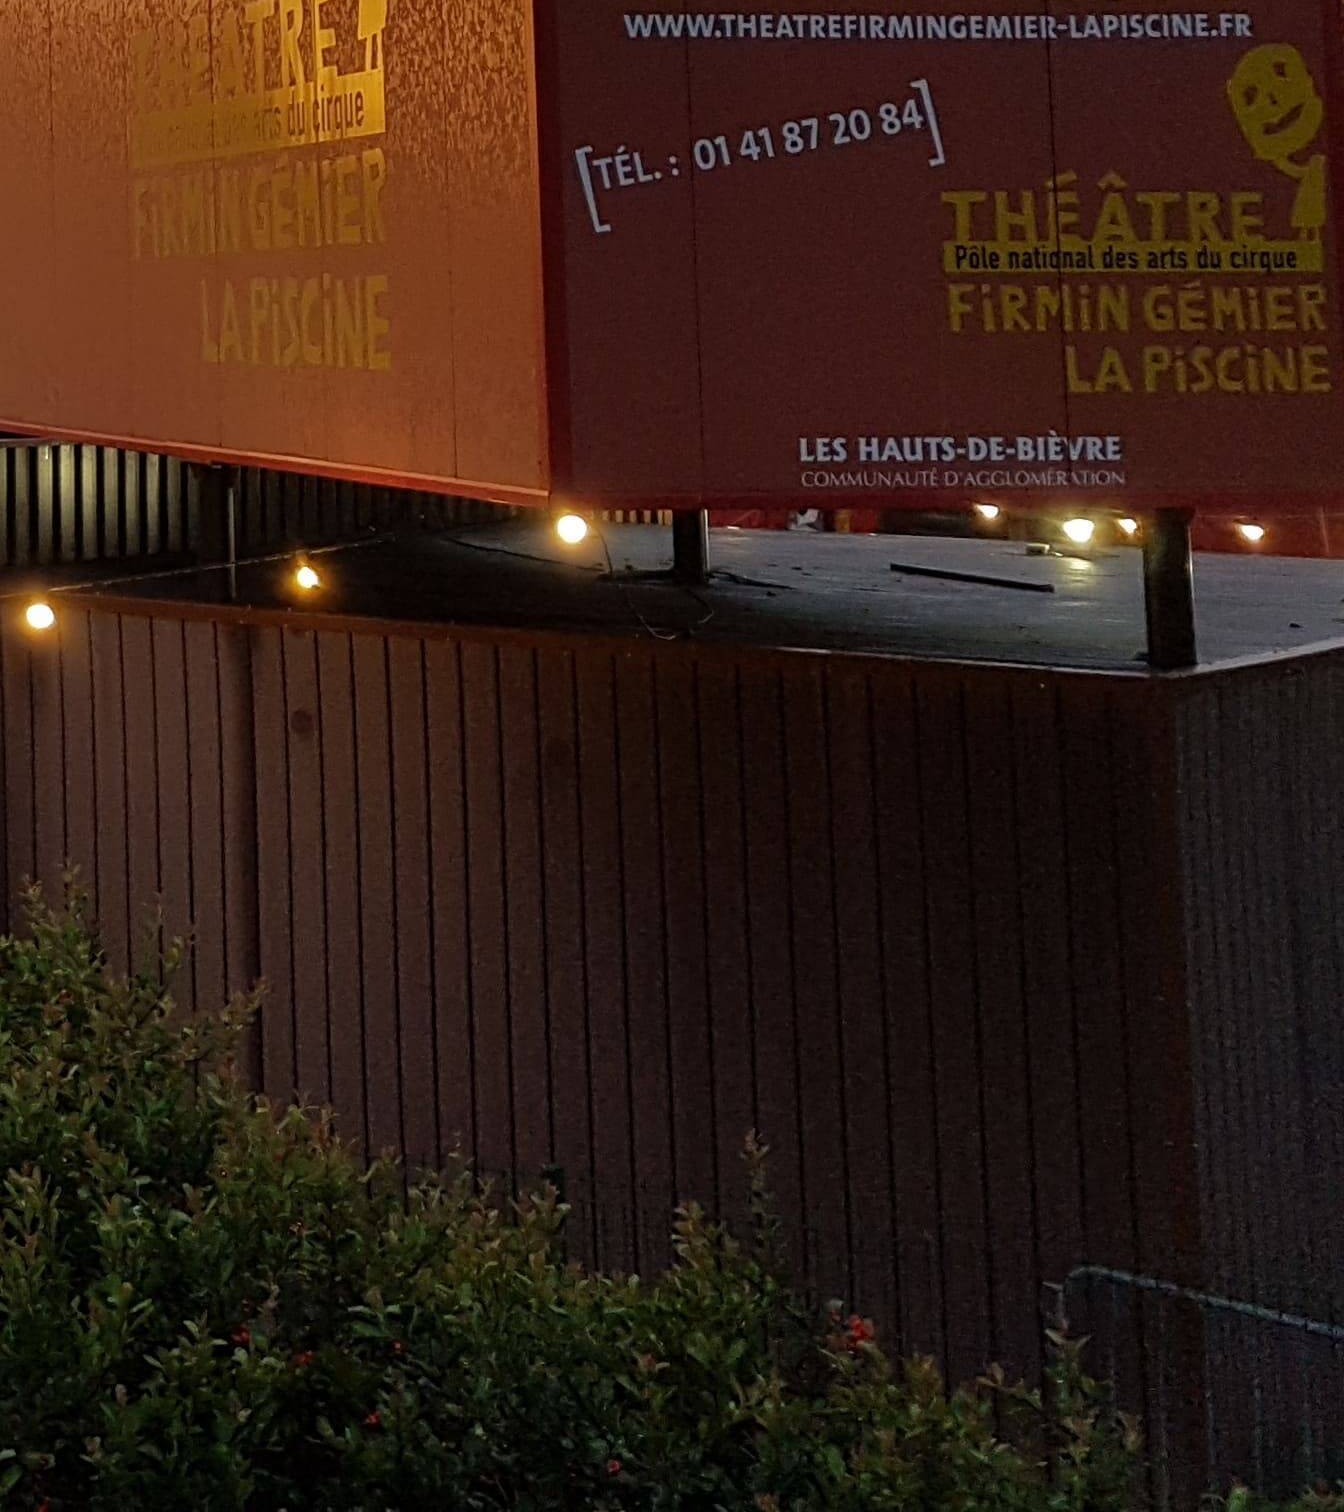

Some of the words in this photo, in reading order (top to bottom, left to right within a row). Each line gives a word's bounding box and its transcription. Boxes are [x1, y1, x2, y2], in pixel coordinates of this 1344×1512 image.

[624, 14, 1253, 39] WWW.THEATREFIRMINGEMIER-LAPISCINE.FR
[288, 90, 306, 137] du
[313, 84, 365, 137] cirque
[694, 135, 732, 172] 01
[740, 126, 775, 161] 41
[782, 117, 818, 154] 87
[829, 109, 871, 145] 20
[941, 169, 1264, 241] THÉÂTRE
[956, 244, 999, 270] Pôle
[1009, 245, 1093, 270] national
[1102, 245, 1138, 270] des
[1148, 248, 1187, 270] arts
[1197, 245, 1221, 270] du
[1231, 246, 1297, 274] cirque
[1065, 343, 1133, 394] LA
[798, 437, 847, 463] LES
[858, 430, 1122, 463] HAUTS-DE-BIÈVRE
[801, 468, 938, 487] COMMUNAUTÉ
[945, 468, 1126, 487] D'AGGLOMÉRATION
